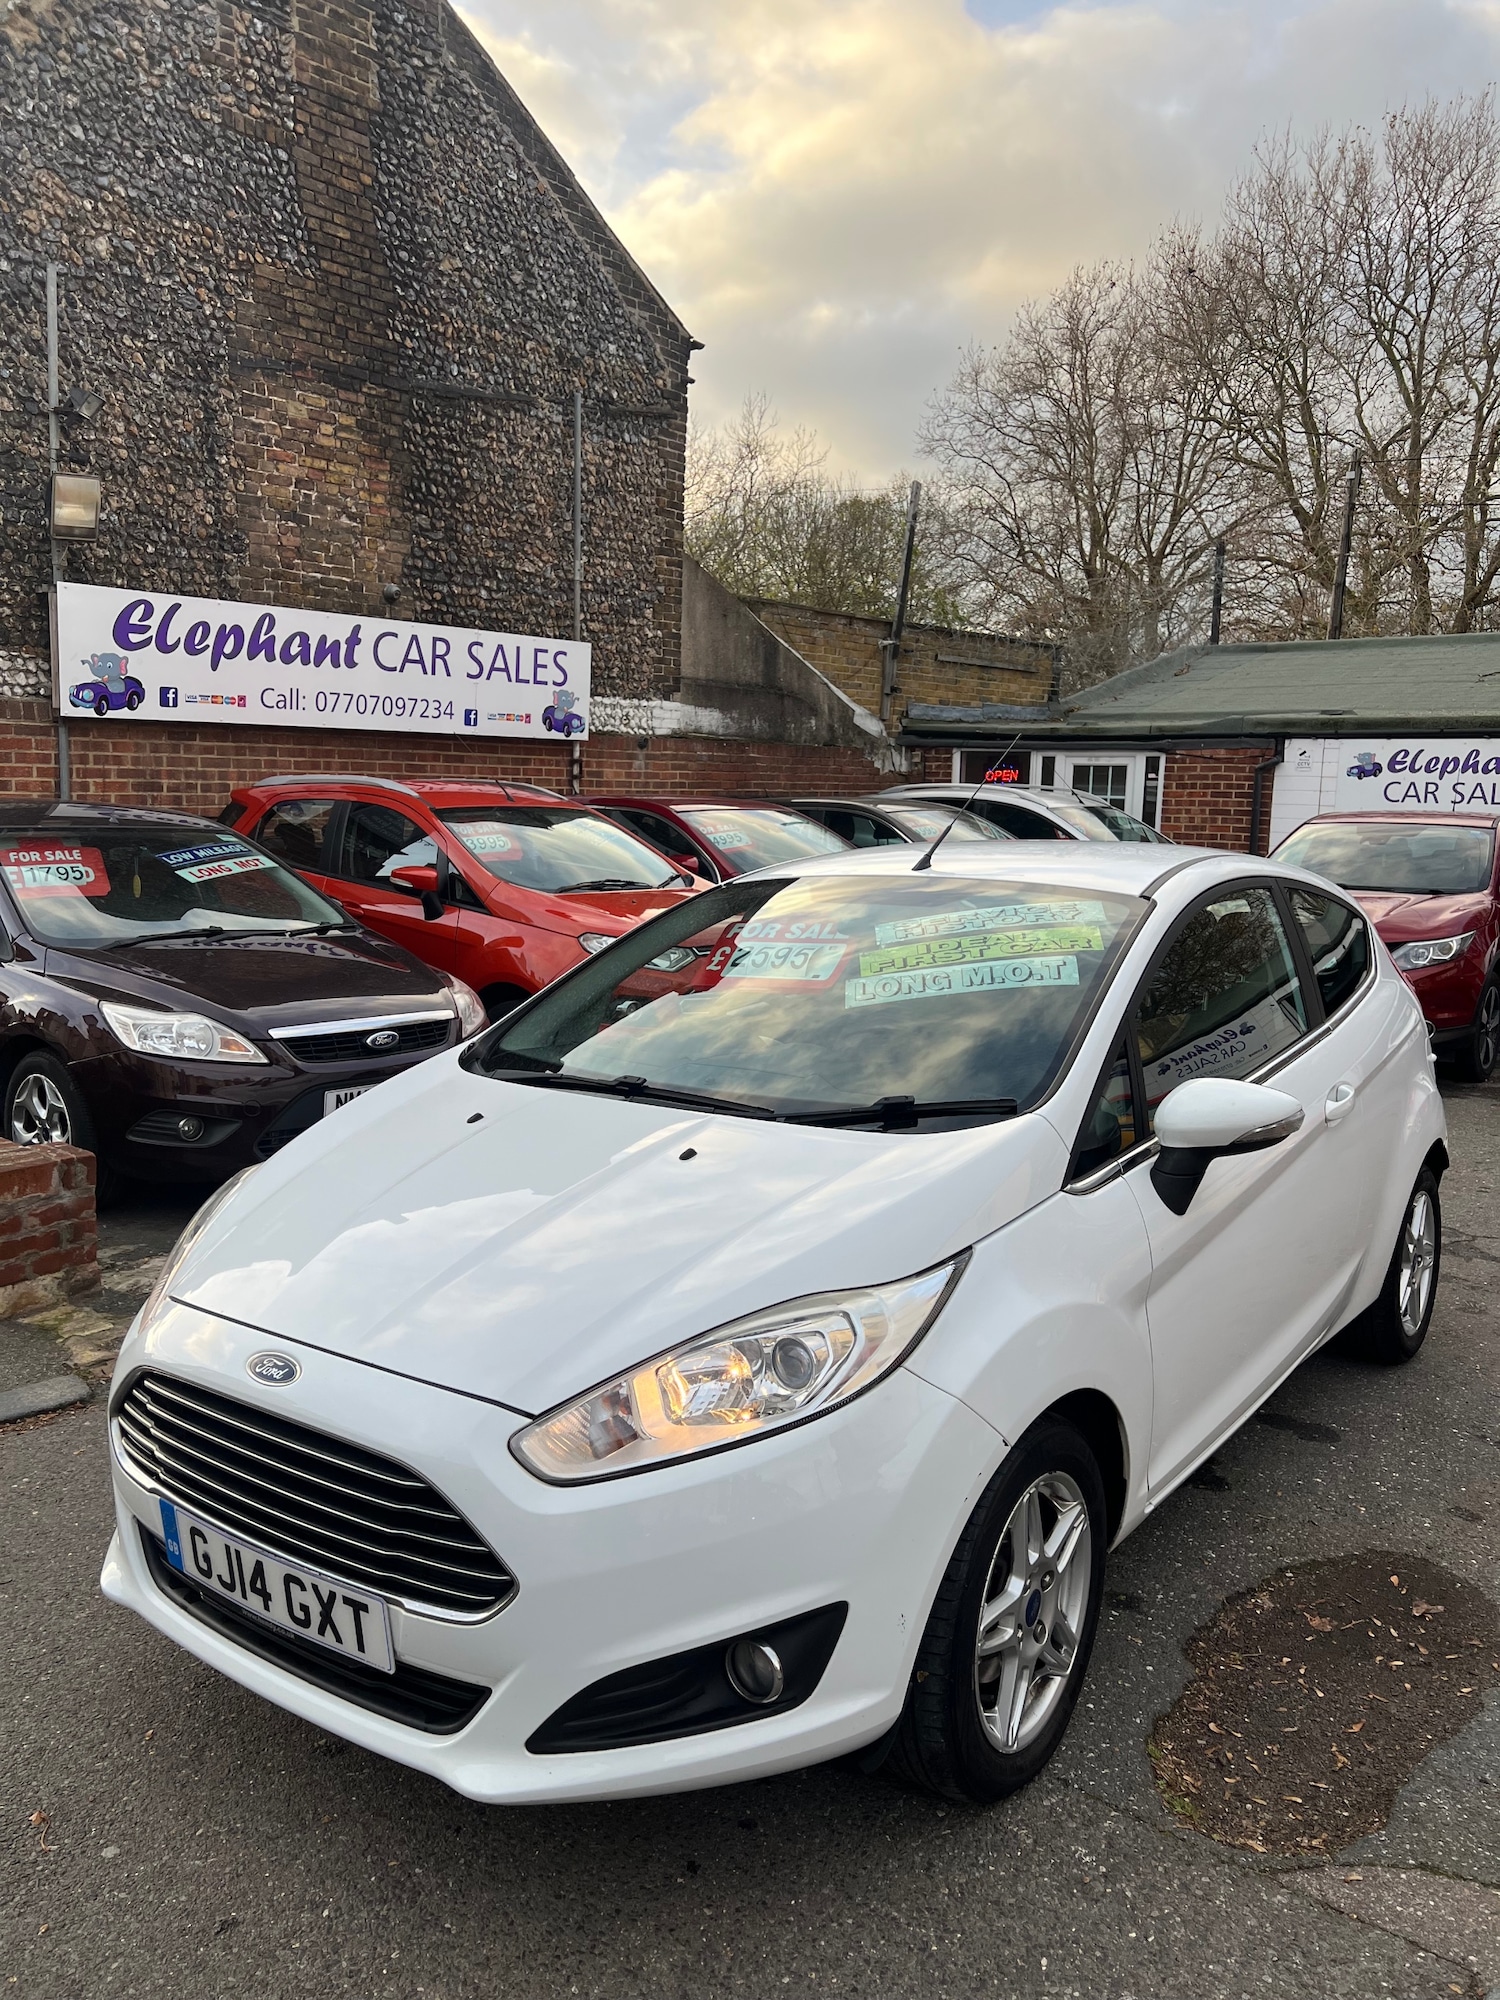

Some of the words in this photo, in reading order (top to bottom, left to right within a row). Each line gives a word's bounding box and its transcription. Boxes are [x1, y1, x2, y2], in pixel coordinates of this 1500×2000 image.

[112, 599, 362, 672] Elephant
[372, 631, 452, 677] CAR
[466, 641, 569, 688] SALES
[260, 687, 306, 712] Call:
[315, 691, 455, 720] 07707097234
[985, 769, 1019, 781] OPEN
[1383, 781, 1439, 803] CAR
[454, 826, 475, 834] FOR
[712, 832, 743, 846] 4995
[162, 852, 195, 864] LOW
[194, 844, 249, 858] MILEAGE
[465, 836, 506, 851] 3995
[9, 851, 42, 862] FOR
[44, 850, 82, 861] SALE
[24, 865, 84, 883] 1795
[188, 864, 233, 879] LONG
[233, 858, 266, 870] MOT
[726, 923, 781, 939] FOR
[896, 911, 1083, 939] HISTORY
[871, 946, 991, 973] FIRST
[1000, 935, 1093, 953] CAR
[916, 932, 1038, 955] IDEAL
[855, 970, 952, 1001] LONG
[961, 959, 1067, 987] M.O.T
[255, 1357, 289, 1379] Ford
[168, 1539, 180, 1556] GB
[189, 1526, 272, 1613] GJ14
[283, 1573, 370, 1654] GXT
